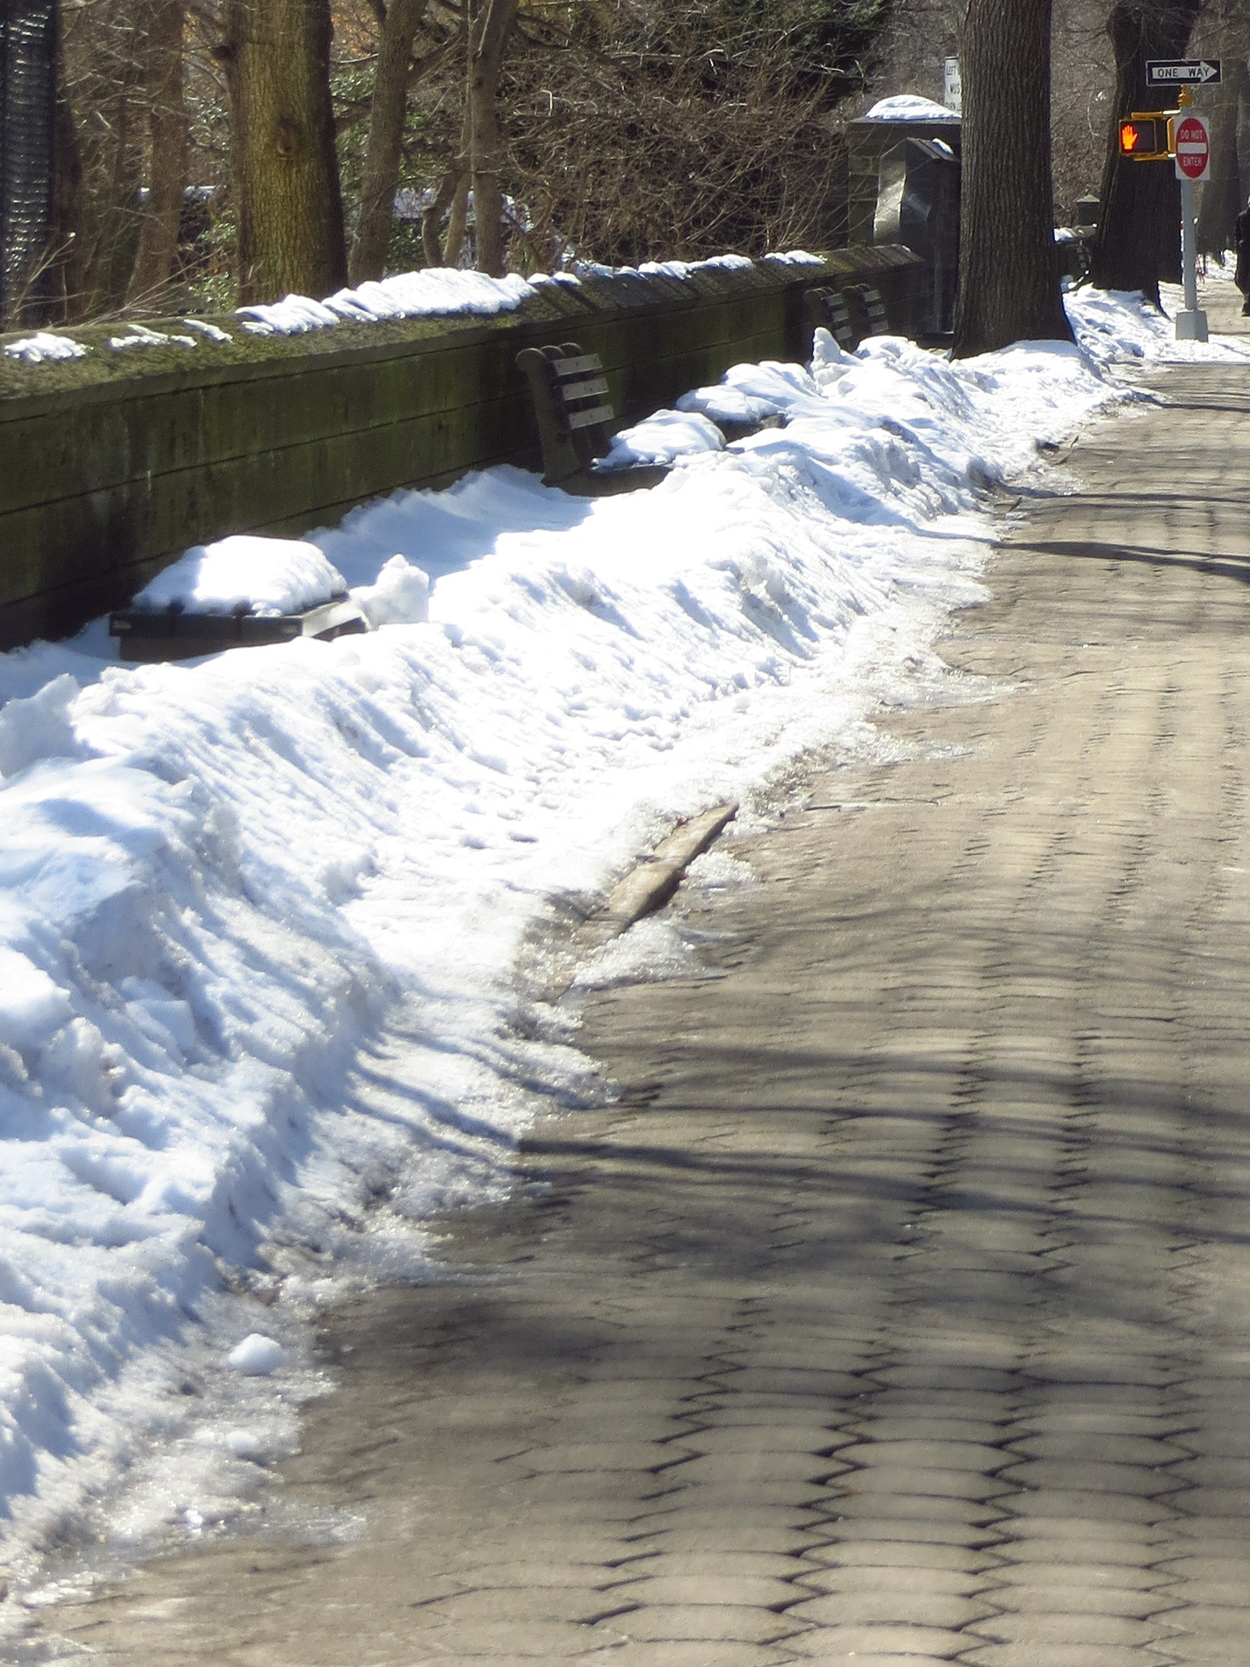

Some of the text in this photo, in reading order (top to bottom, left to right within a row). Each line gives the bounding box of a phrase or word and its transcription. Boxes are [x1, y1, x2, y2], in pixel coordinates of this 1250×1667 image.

[1157, 67, 1210, 78] ONE WAY
[1181, 130, 1203, 139] DO NOT
[1183, 157, 1202, 166] ENTER
